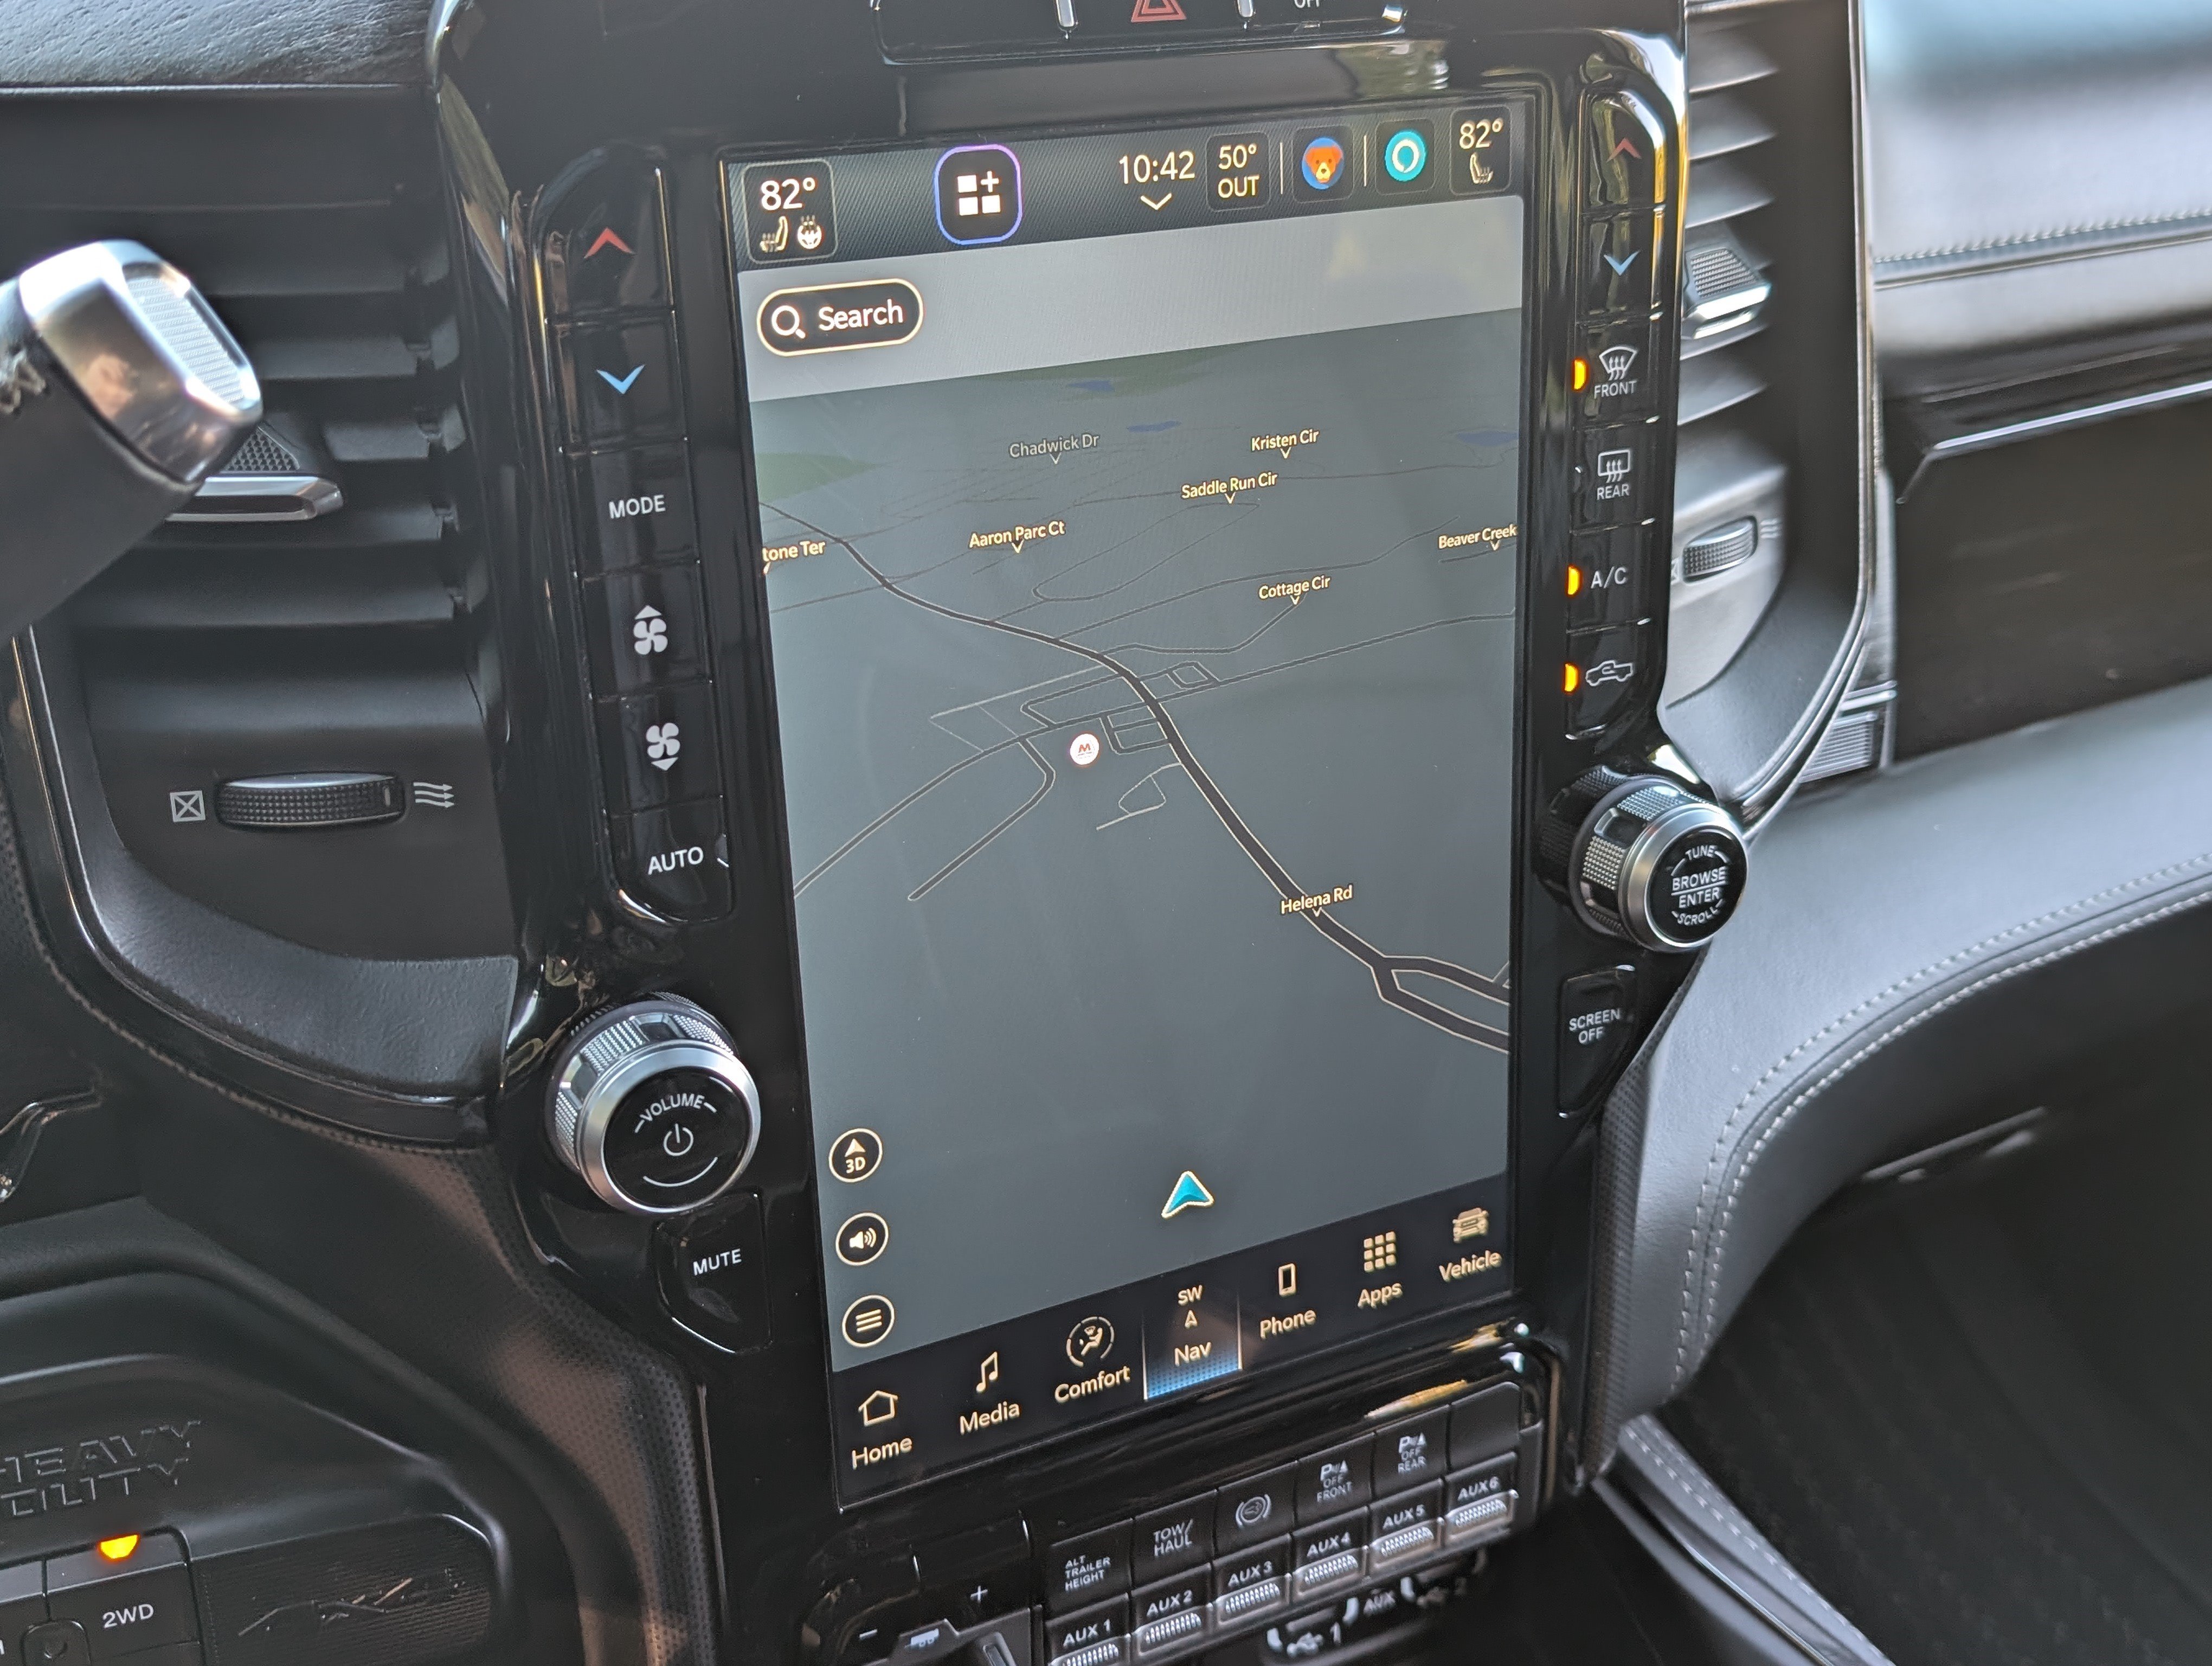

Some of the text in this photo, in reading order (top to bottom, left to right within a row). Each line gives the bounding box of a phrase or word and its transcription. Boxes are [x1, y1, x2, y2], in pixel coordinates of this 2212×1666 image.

[1120, 151, 1195, 184] 10:42
[1218, 175, 1259, 198] OUT
[819, 299, 903, 331] Search
[1594, 381, 1637, 398] FRONT
[1009, 433, 1099, 458] Chadwick Dr
[1251, 429, 1319, 451] Kristen Cir
[1182, 472, 1277, 499] Saddle Run Cir
[1597, 484, 1629, 500] REAR
[609, 495, 666, 518] MODE
[969, 521, 1065, 548] Aaron Parc Ct
[1438, 523, 1517, 549] Beaver Creek
[799, 541, 826, 556] Ter
[1259, 575, 1330, 599] Cottage Cir
[1591, 566, 1627, 589] A/C
[648, 846, 704, 874] AUTO
[1685, 845, 1716, 860] TUNE
[1673, 866, 1726, 891] BROWSE
[1281, 885, 1353, 914] Helena Rd
[1679, 887, 1720, 908] ENTER
[1677, 907, 1718, 926] SCROLL
[1569, 1009, 1620, 1031] SCREEN
[1579, 1027, 1603, 1045] OFF
[640, 1094, 704, 1124] VOLUME
[846, 1158, 865, 1174] 3D
[693, 1248, 742, 1276] MUTE
[1439, 1250, 1502, 1282] Vehicle
[1178, 1284, 1203, 1305] SW
[1358, 1282, 1403, 1309] Apps
[1260, 1309, 1316, 1338] Phone
[1174, 1341, 1211, 1366] Nav
[1054, 1364, 1131, 1403] Comfort
[960, 1401, 1020, 1434] Media
[852, 1437, 912, 1469] Home
[1317, 1482, 1352, 1503] FRONT
[1458, 1476, 1499, 1501] AUX 6
[1382, 1505, 1425, 1529] AUX 5
[1154, 1534, 1192, 1556] HAUL
[1307, 1532, 1351, 1558] AUX 4
[1065, 1555, 1086, 1569] ALT
[1065, 1556, 1111, 1579] TRAILER
[1228, 1561, 1273, 1587] AUX 3
[1065, 1569, 1104, 1591] HEIGHT
[1147, 1590, 1193, 1617] AUX 2
[102, 1604, 155, 1629] 2WD
[1063, 1619, 1111, 1647] AUX 1
